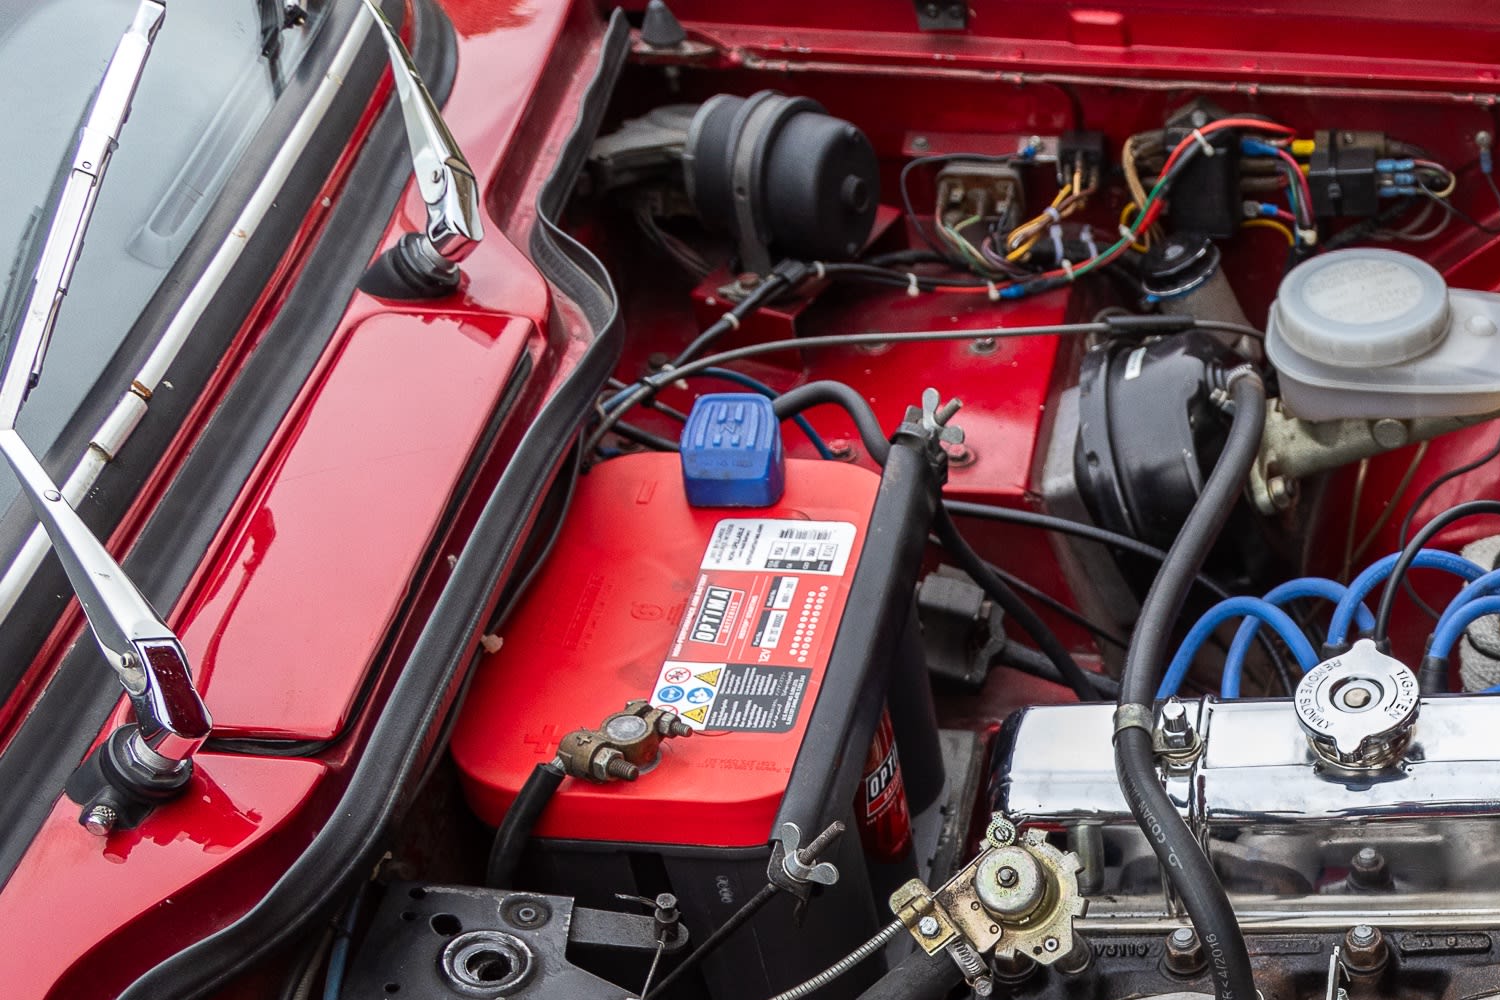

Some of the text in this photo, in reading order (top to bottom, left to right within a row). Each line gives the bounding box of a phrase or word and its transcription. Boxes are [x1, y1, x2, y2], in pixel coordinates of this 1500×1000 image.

[696, 589, 732, 640] OPTIMA
[721, 601, 739, 634] BATTERIES
[757, 649, 772, 663] 12V
[1300, 659, 1342, 729] REMOVE SLOWLY
[1388, 669, 1414, 719] TIGHTEN
[1137, 803, 1167, 845] CODAN
